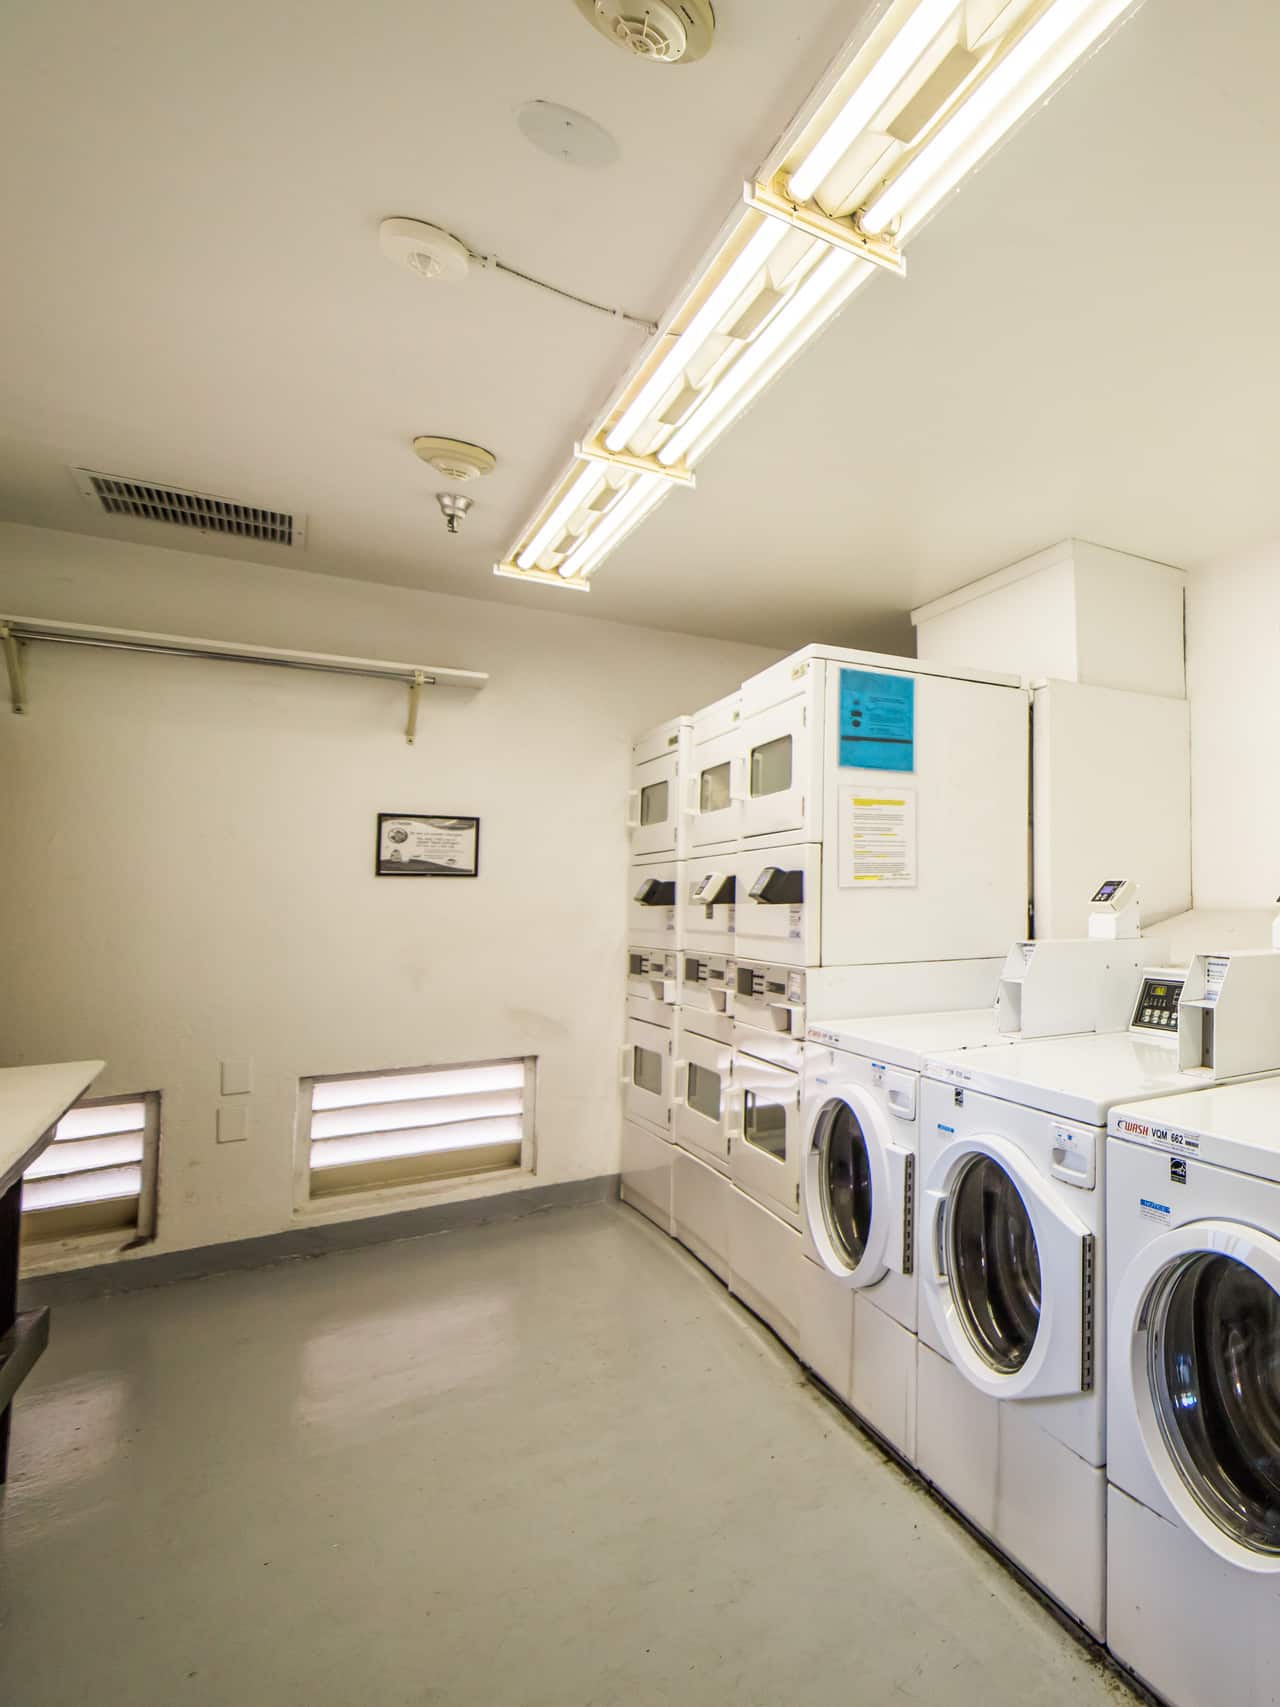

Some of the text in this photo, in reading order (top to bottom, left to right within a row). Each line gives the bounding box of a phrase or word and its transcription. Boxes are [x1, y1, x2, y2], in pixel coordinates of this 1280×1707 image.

[1124, 1121, 1184, 1144] WASH VQM 662
